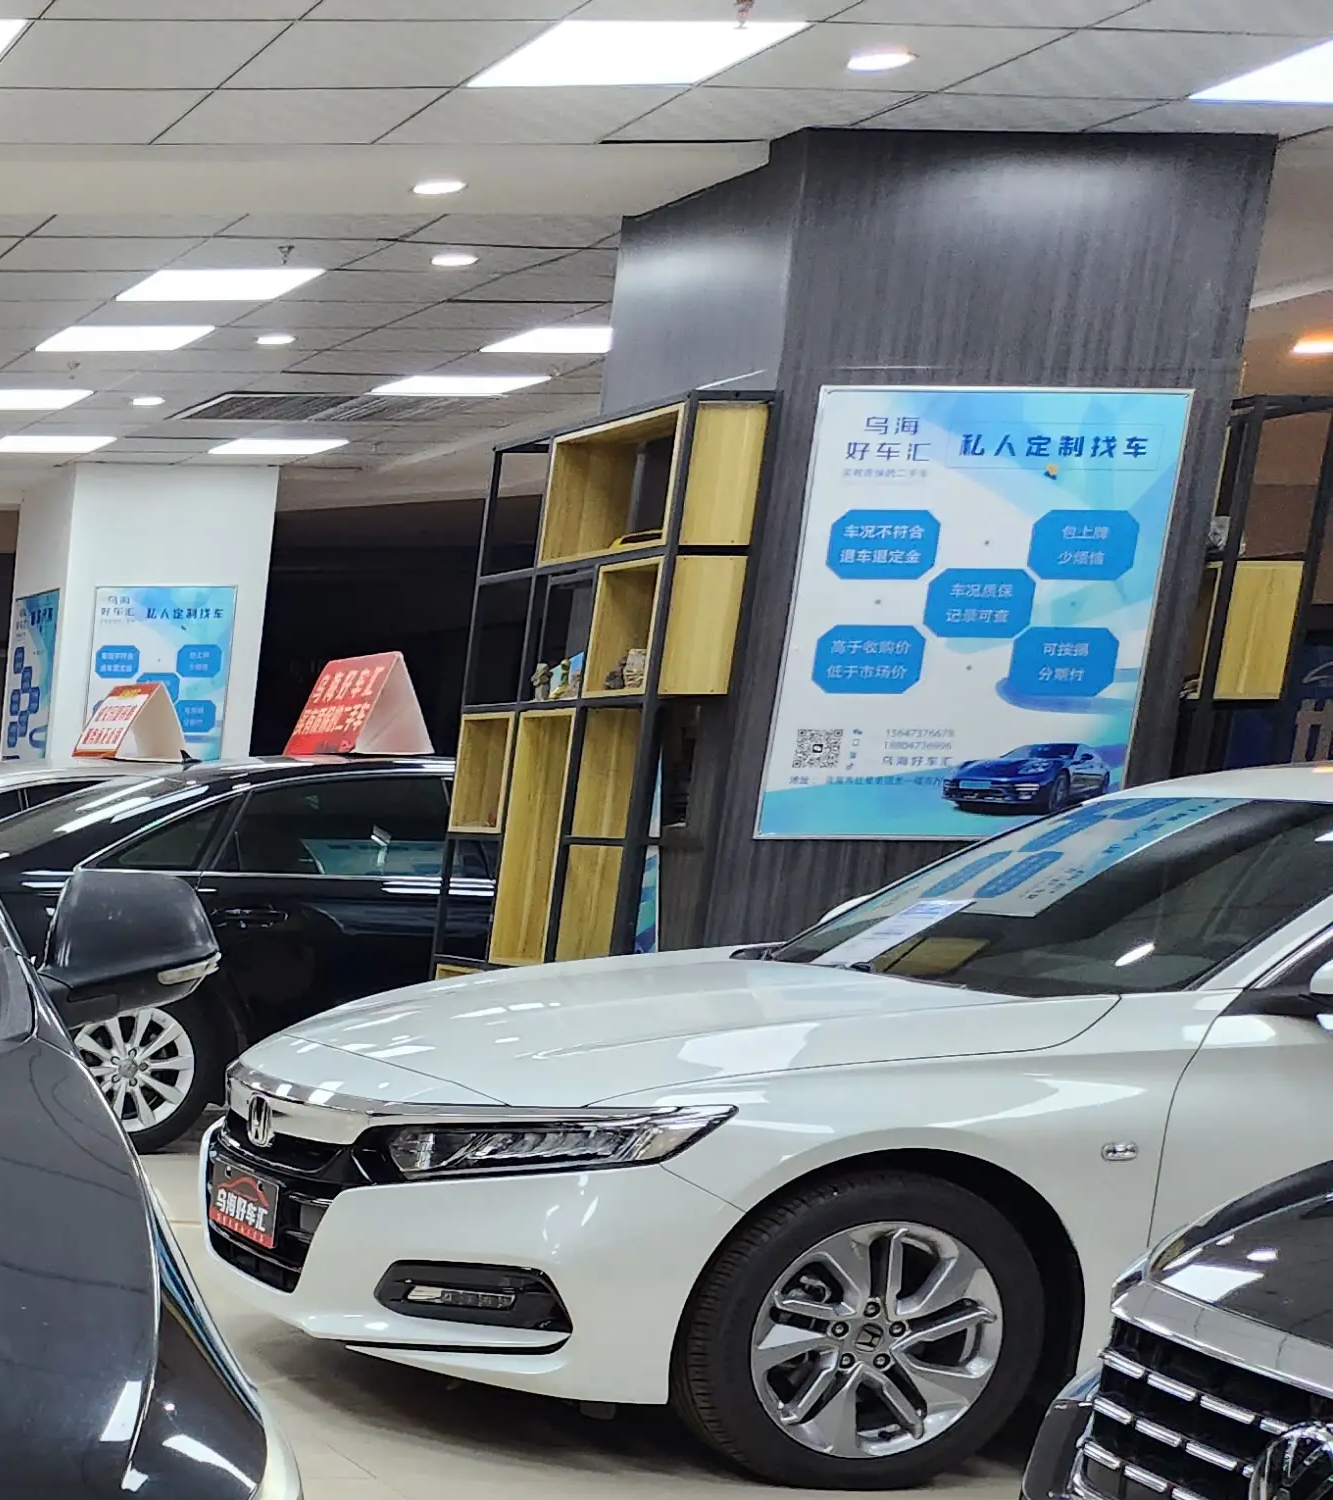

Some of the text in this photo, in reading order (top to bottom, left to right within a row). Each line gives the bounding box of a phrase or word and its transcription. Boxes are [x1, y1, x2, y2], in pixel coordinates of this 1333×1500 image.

[864, 416, 920, 435] 乌海
[845, 442, 932, 462] 好车汇
[958, 434, 1149, 459] 私人定制找车
[843, 524, 925, 539] 车况不符合
[830, 639, 911, 655] 高于收购价
[827, 665, 907, 680] 低于市场价
